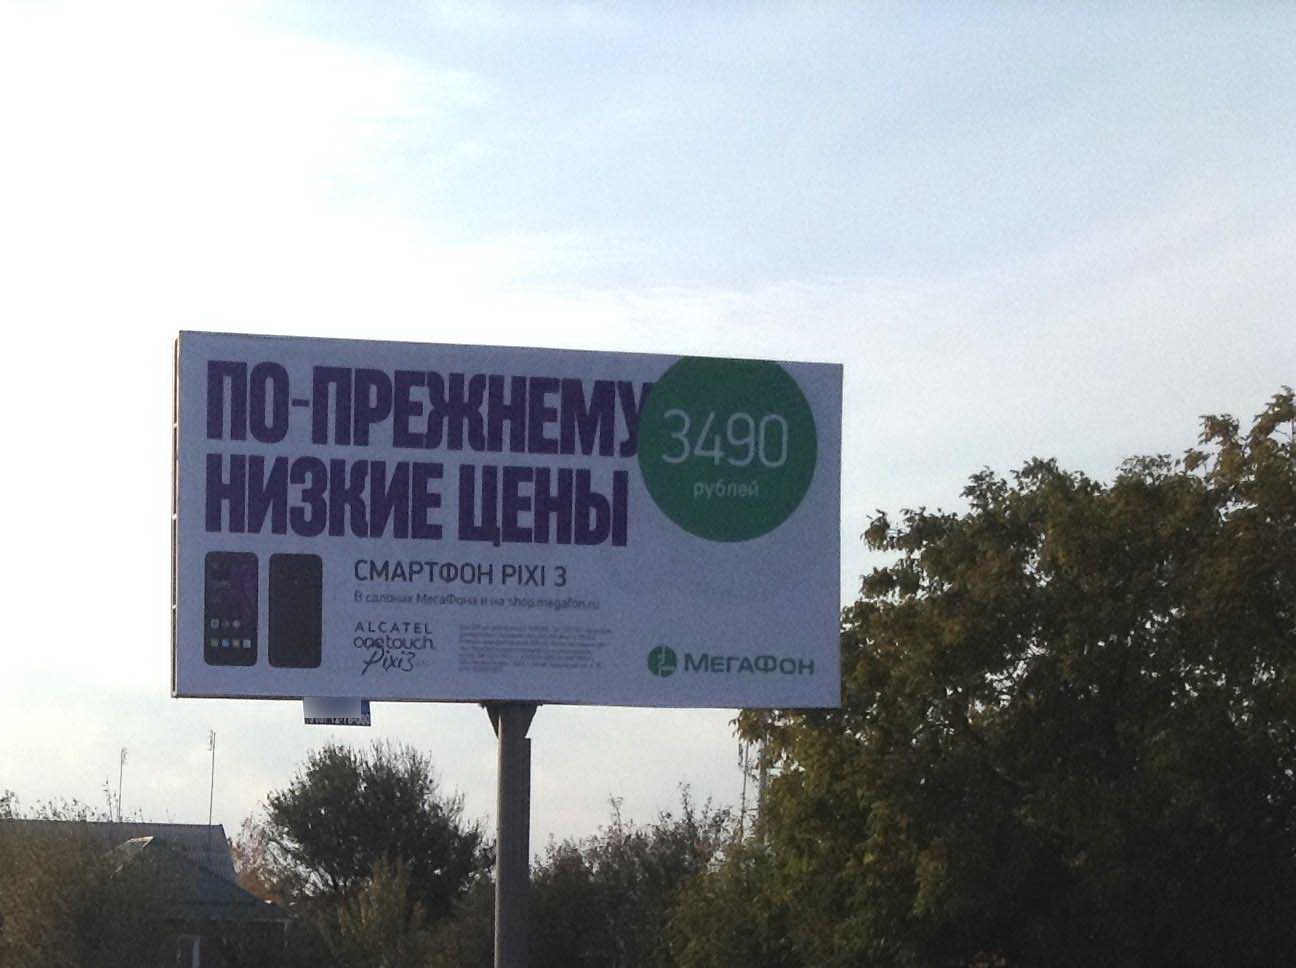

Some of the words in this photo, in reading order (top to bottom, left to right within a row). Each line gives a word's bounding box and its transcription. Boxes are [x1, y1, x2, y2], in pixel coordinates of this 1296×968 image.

[206, 360, 653, 458] ПО-ПРЕЖНЕМУ
[661, 408, 789, 468] 3490
[204, 453, 443, 540] НИЗКИЕ
[458, 464, 629, 547] ЦЕНЫ
[693, 479, 759, 500] рублей
[354, 559, 493, 585] СМАРТФОН
[502, 564, 545, 587] PIXI
[555, 566, 567, 588] 3
[508, 596, 600, 611] shop.megafon.ru
[354, 621, 433, 634] ALCATEL
